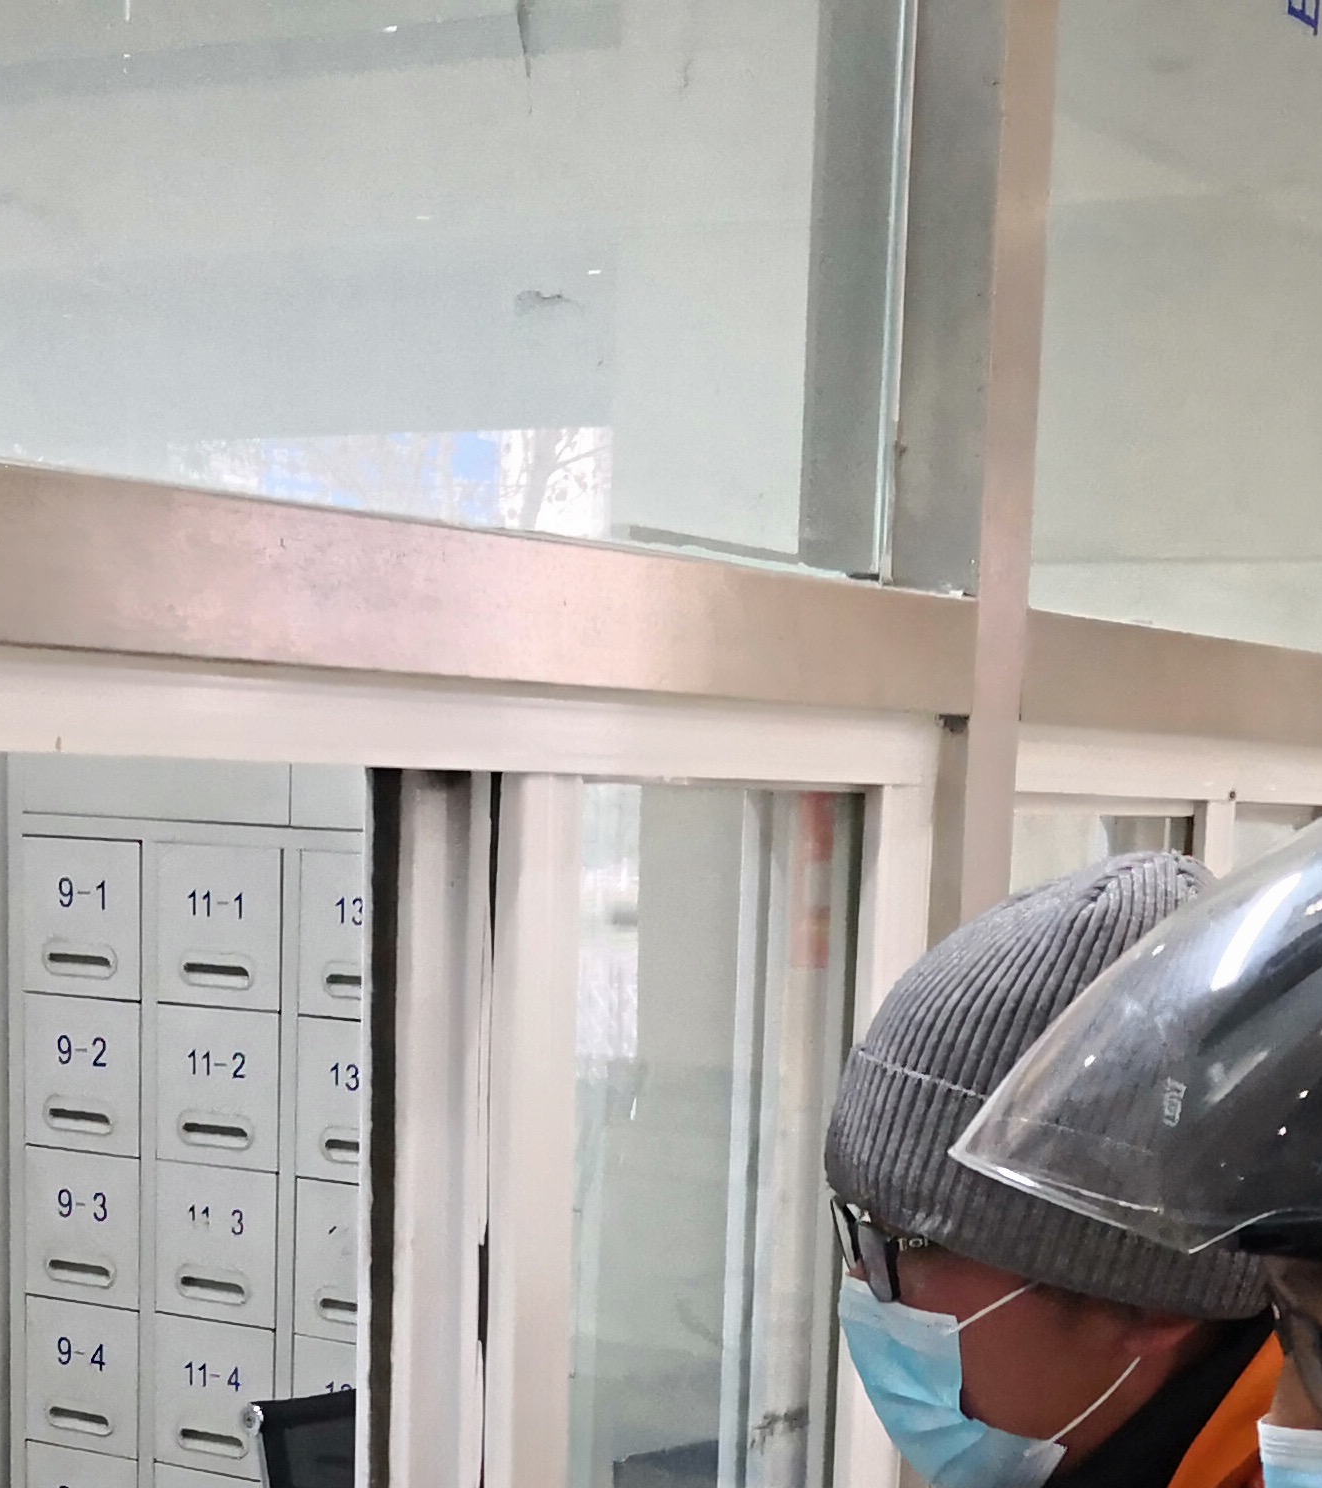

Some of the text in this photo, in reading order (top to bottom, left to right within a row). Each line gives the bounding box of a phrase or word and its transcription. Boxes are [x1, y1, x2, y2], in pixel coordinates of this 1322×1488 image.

[58, 877, 107, 911] 9-1
[187, 889, 244, 920] 11-1
[57, 1034, 107, 1068] 9-2
[187, 1049, 247, 1080] 11-2
[57, 1188, 108, 1223] 9-3
[56, 1337, 107, 1372] 9-4
[184, 1361, 241, 1393] 11-4
